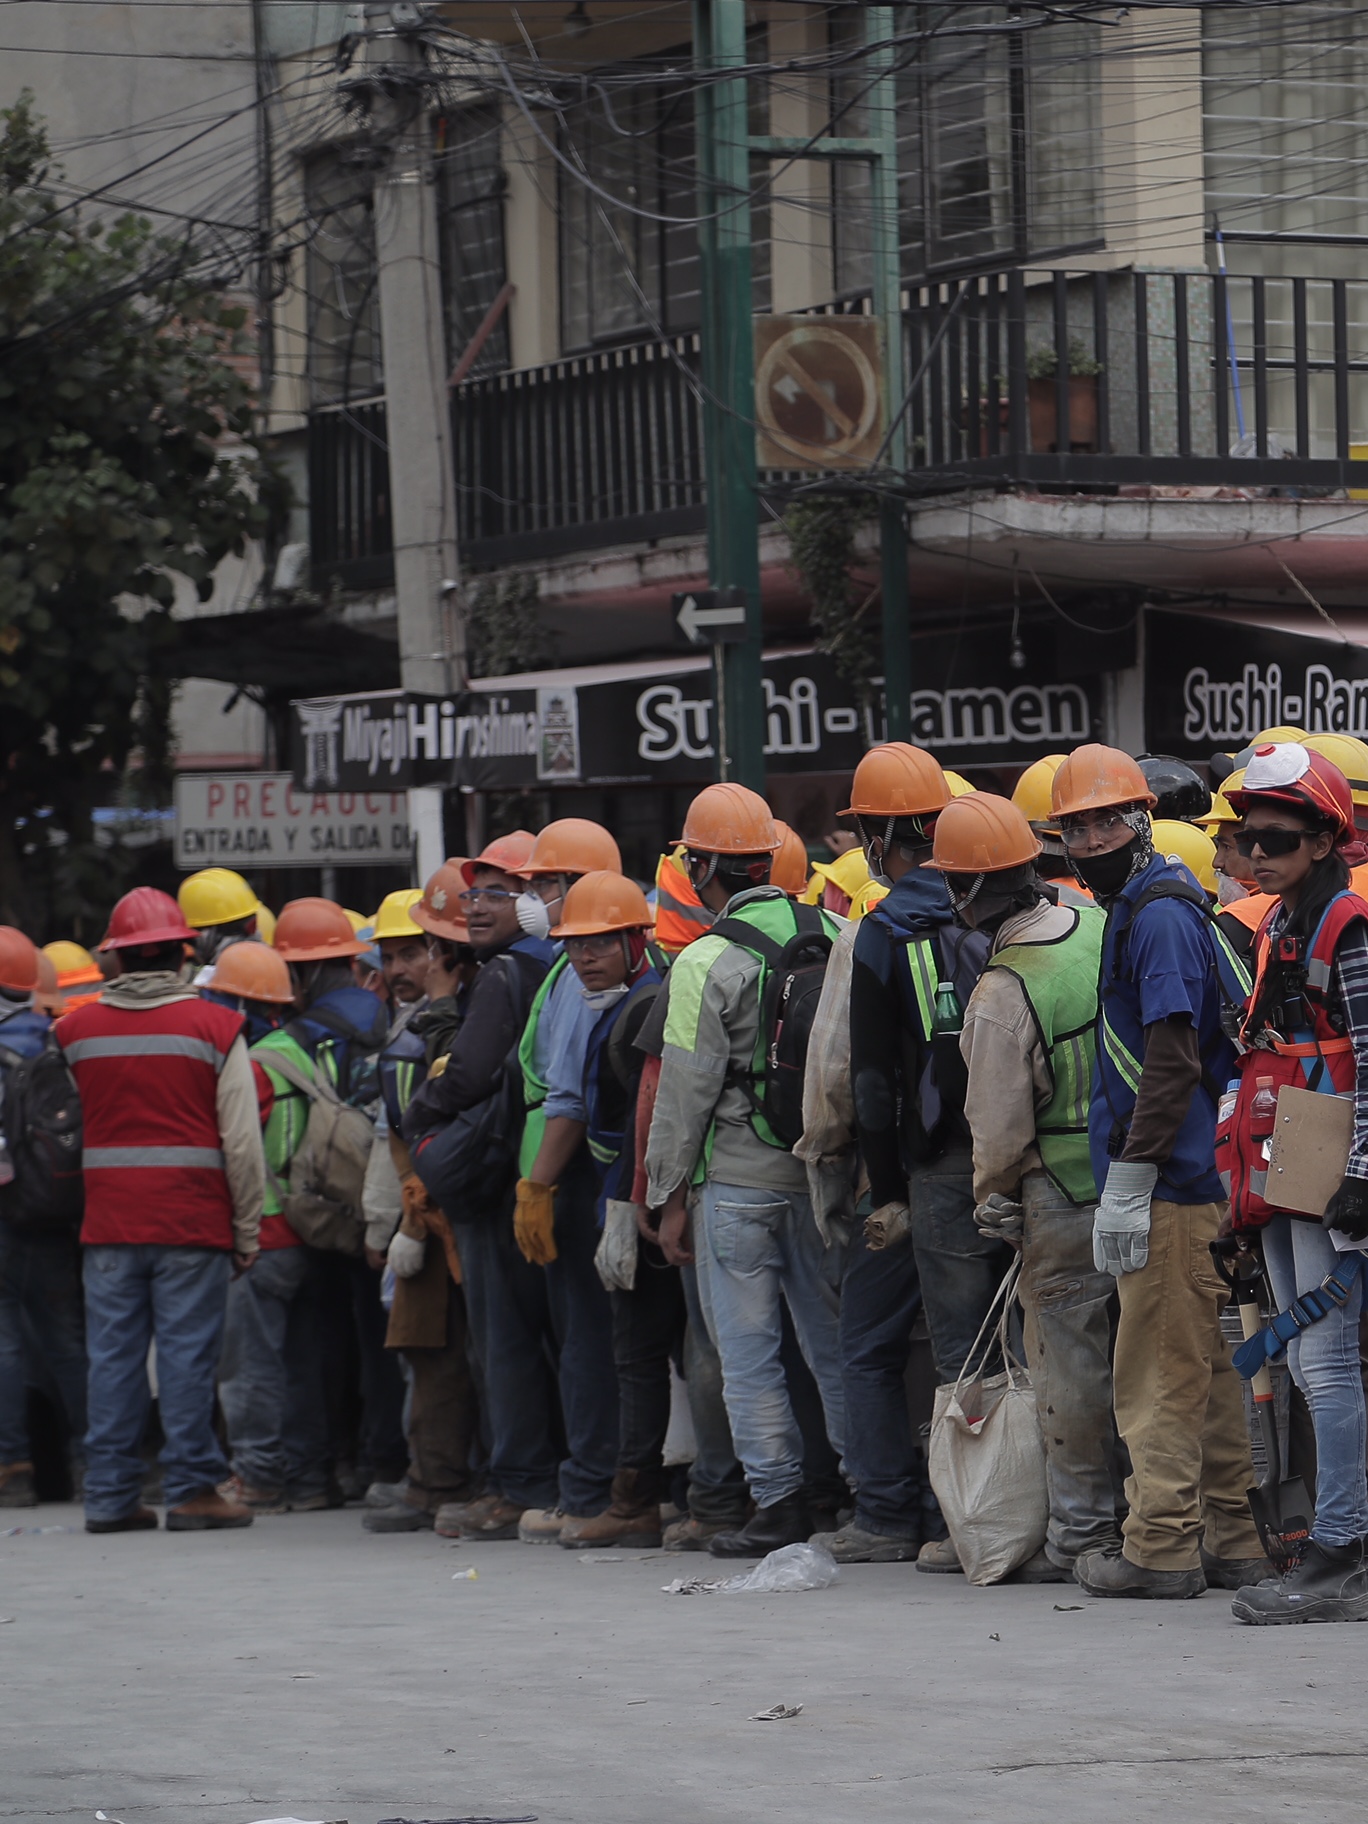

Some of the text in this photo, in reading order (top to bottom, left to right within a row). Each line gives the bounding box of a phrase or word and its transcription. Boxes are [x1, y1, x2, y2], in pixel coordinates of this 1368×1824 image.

[636, 676, 1090, 761] Suhi-amen
[207, 781, 409, 820] PRECAUCI
[184, 826, 271, 855] ENTRADA
[284, 828, 298, 850] Y
[310, 825, 381, 852] SALIDA
